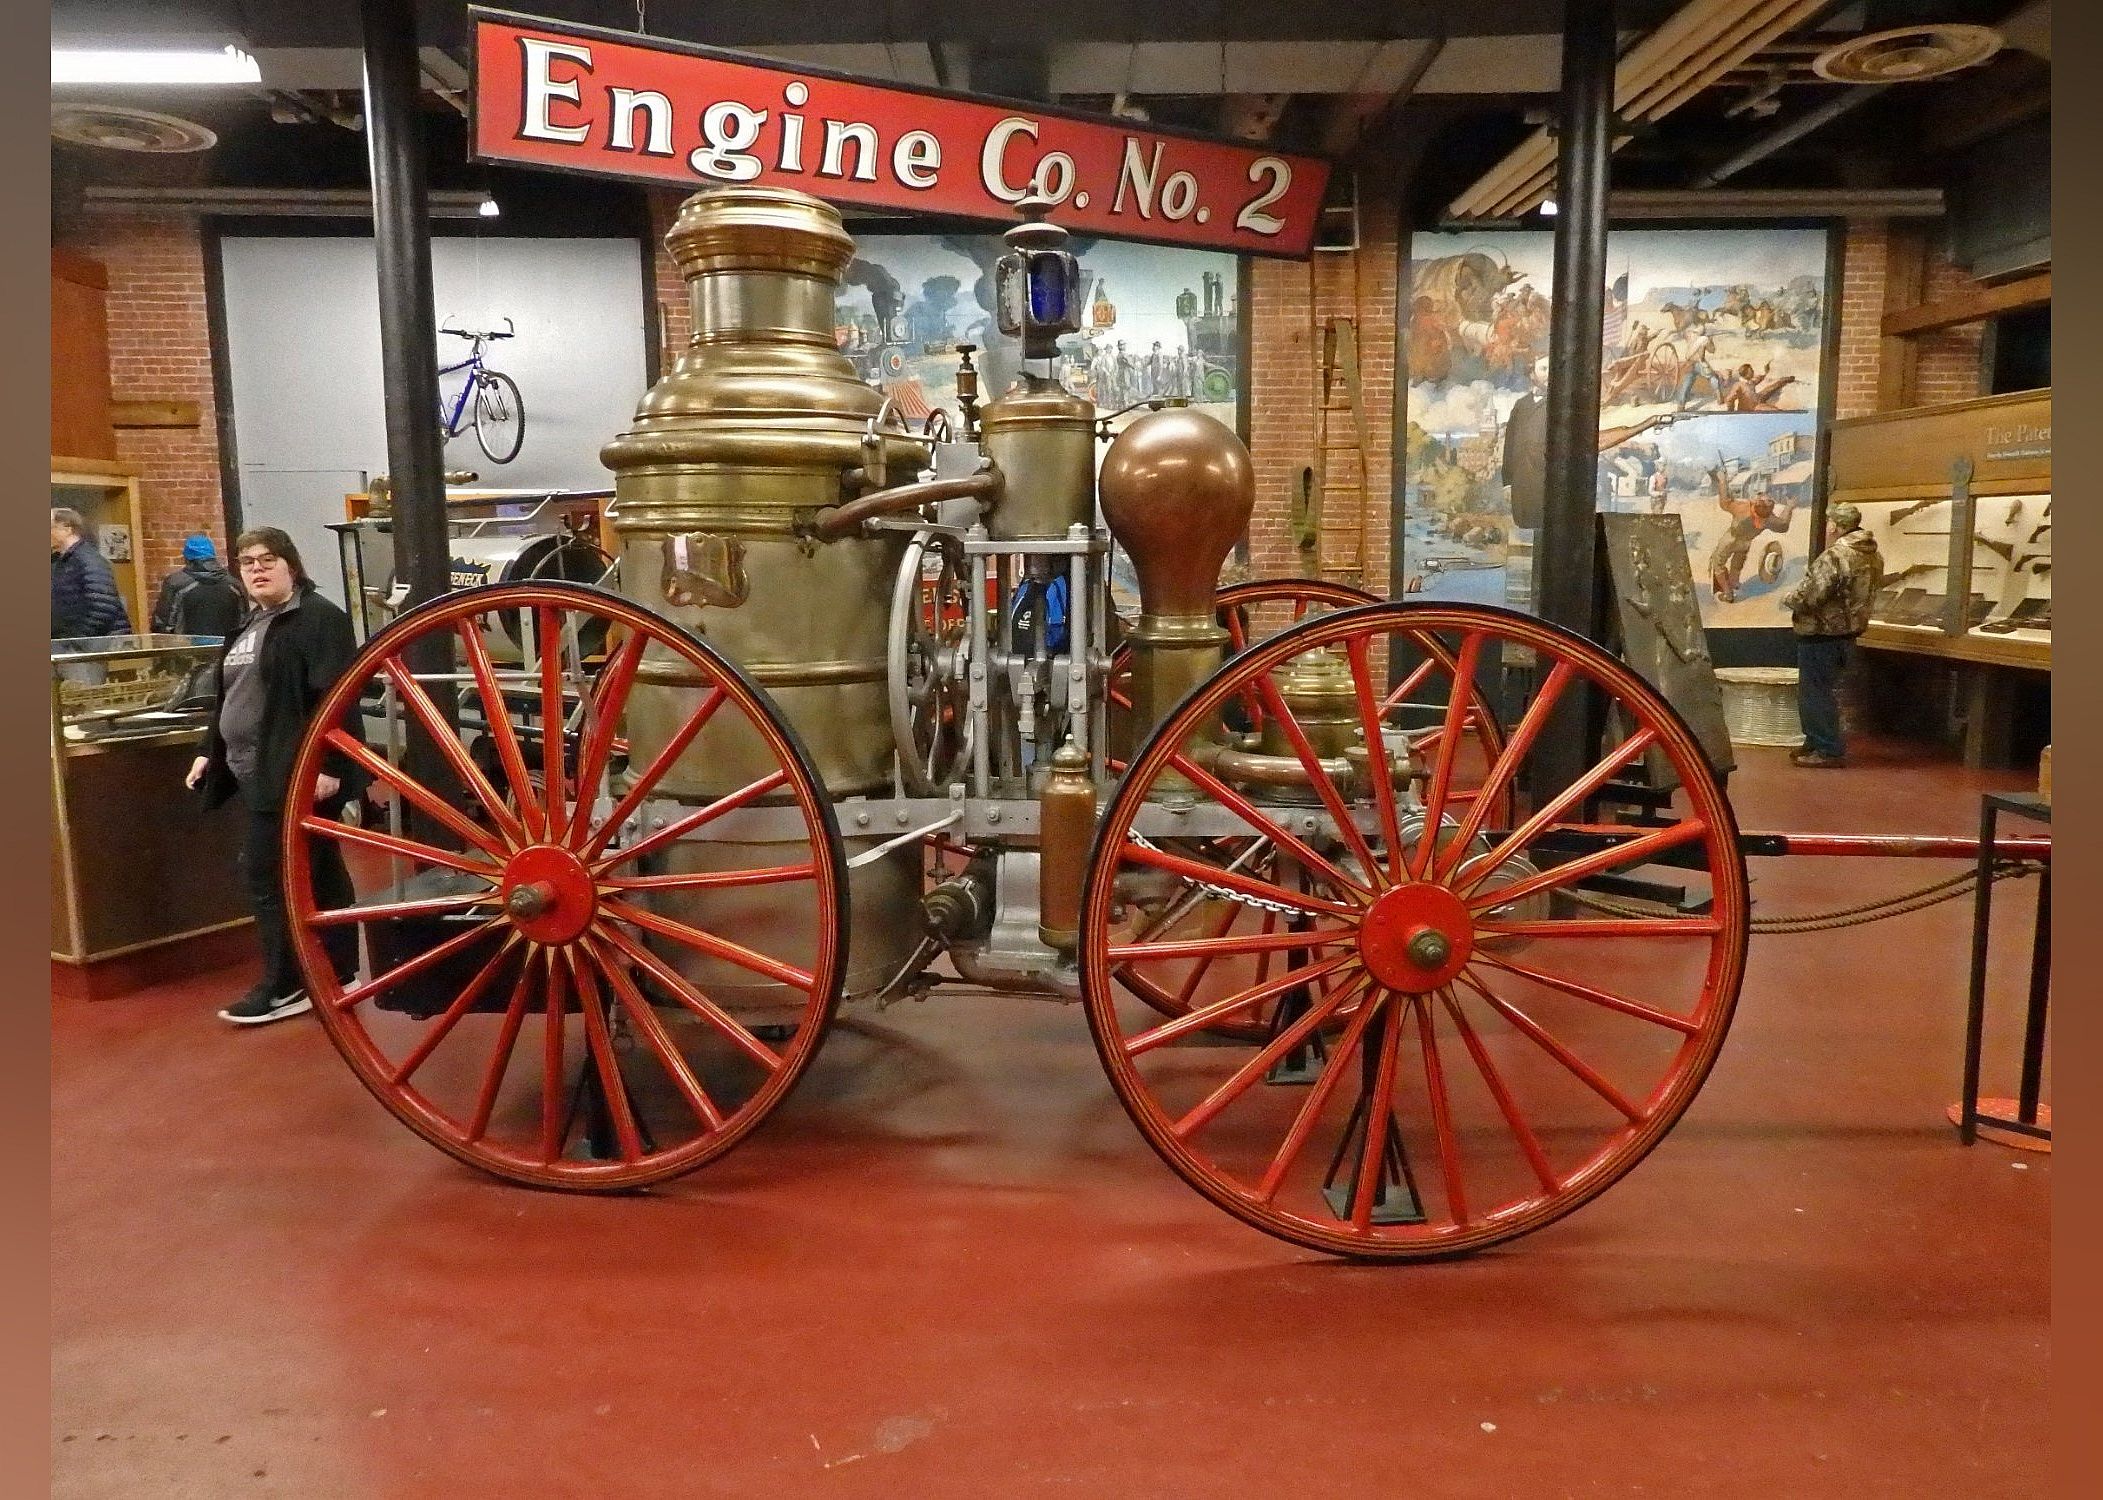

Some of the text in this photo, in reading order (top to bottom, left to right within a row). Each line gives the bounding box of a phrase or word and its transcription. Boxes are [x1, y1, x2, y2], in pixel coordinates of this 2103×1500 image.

[518, 36, 1292, 235] Engine Co. No. 2
[1986, 426, 2012, 445] The
